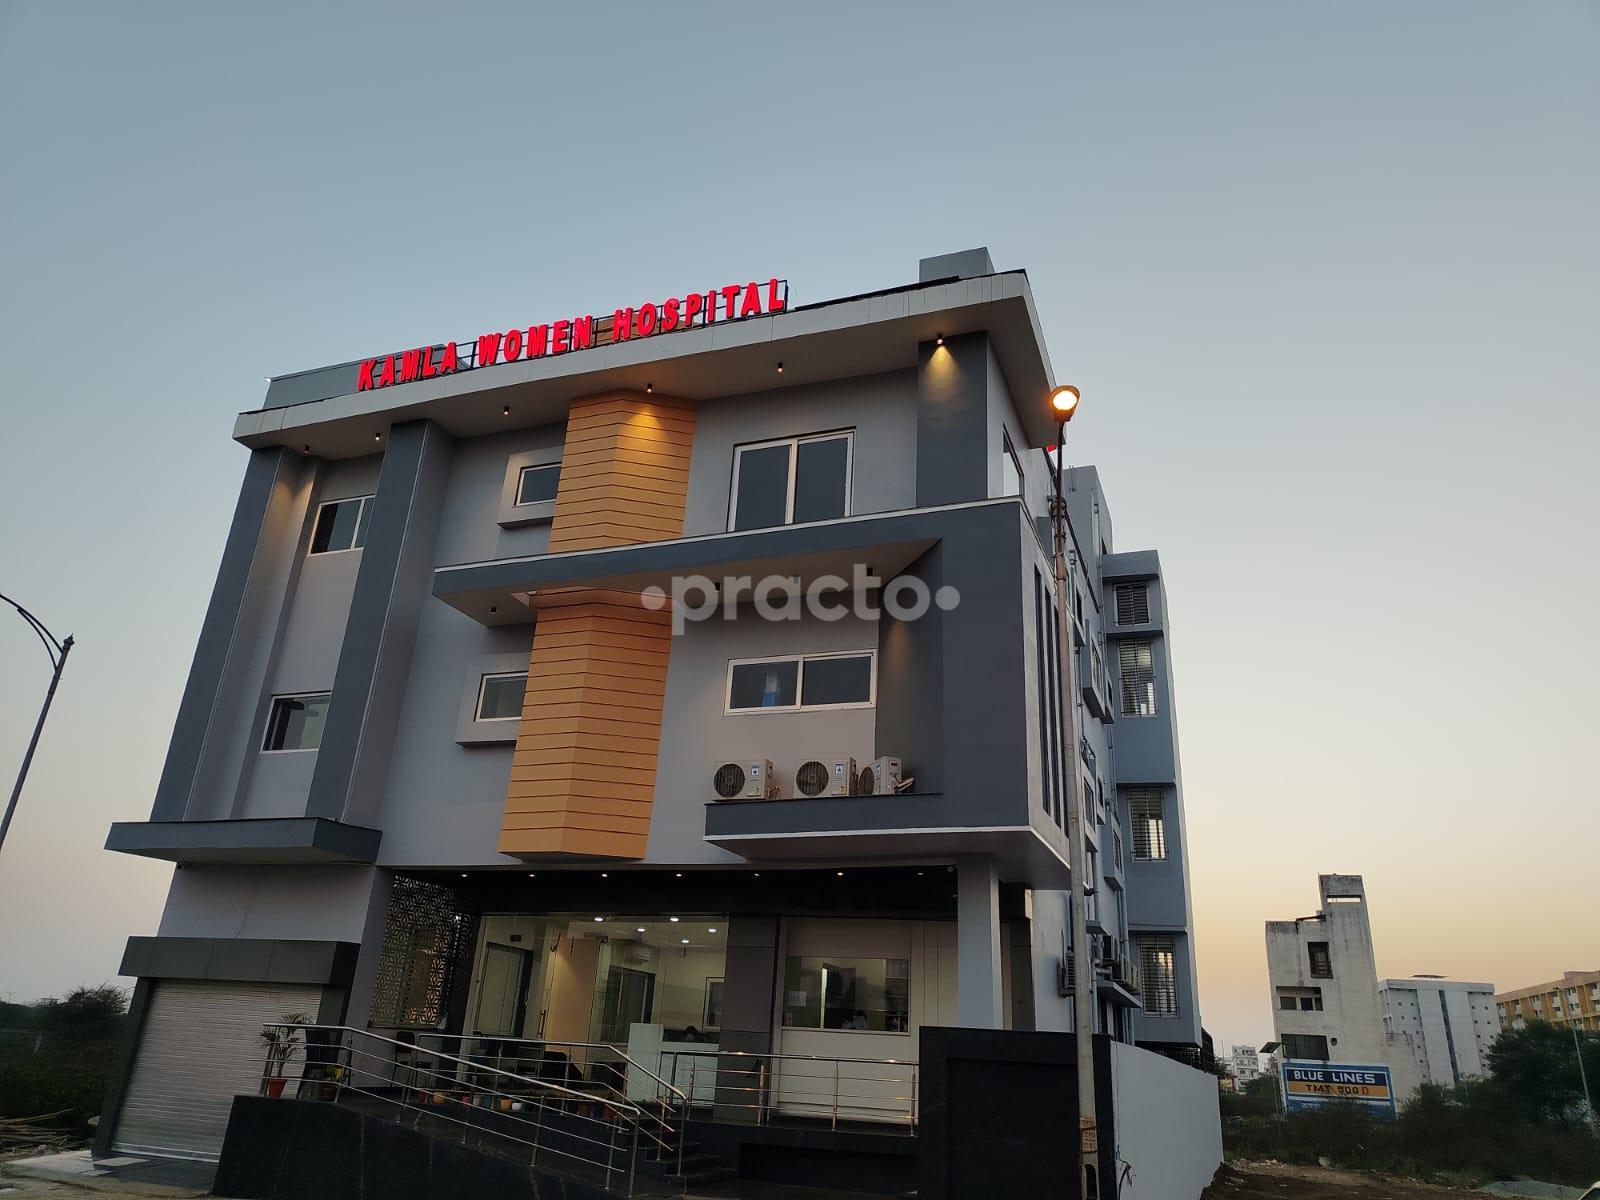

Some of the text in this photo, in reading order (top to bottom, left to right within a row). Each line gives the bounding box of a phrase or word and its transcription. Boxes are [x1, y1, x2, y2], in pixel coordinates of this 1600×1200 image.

[357, 278, 785, 392] KAMLA WOMEN HOSPITAL
[1293, 1070, 1376, 1084] BLUE LINES
